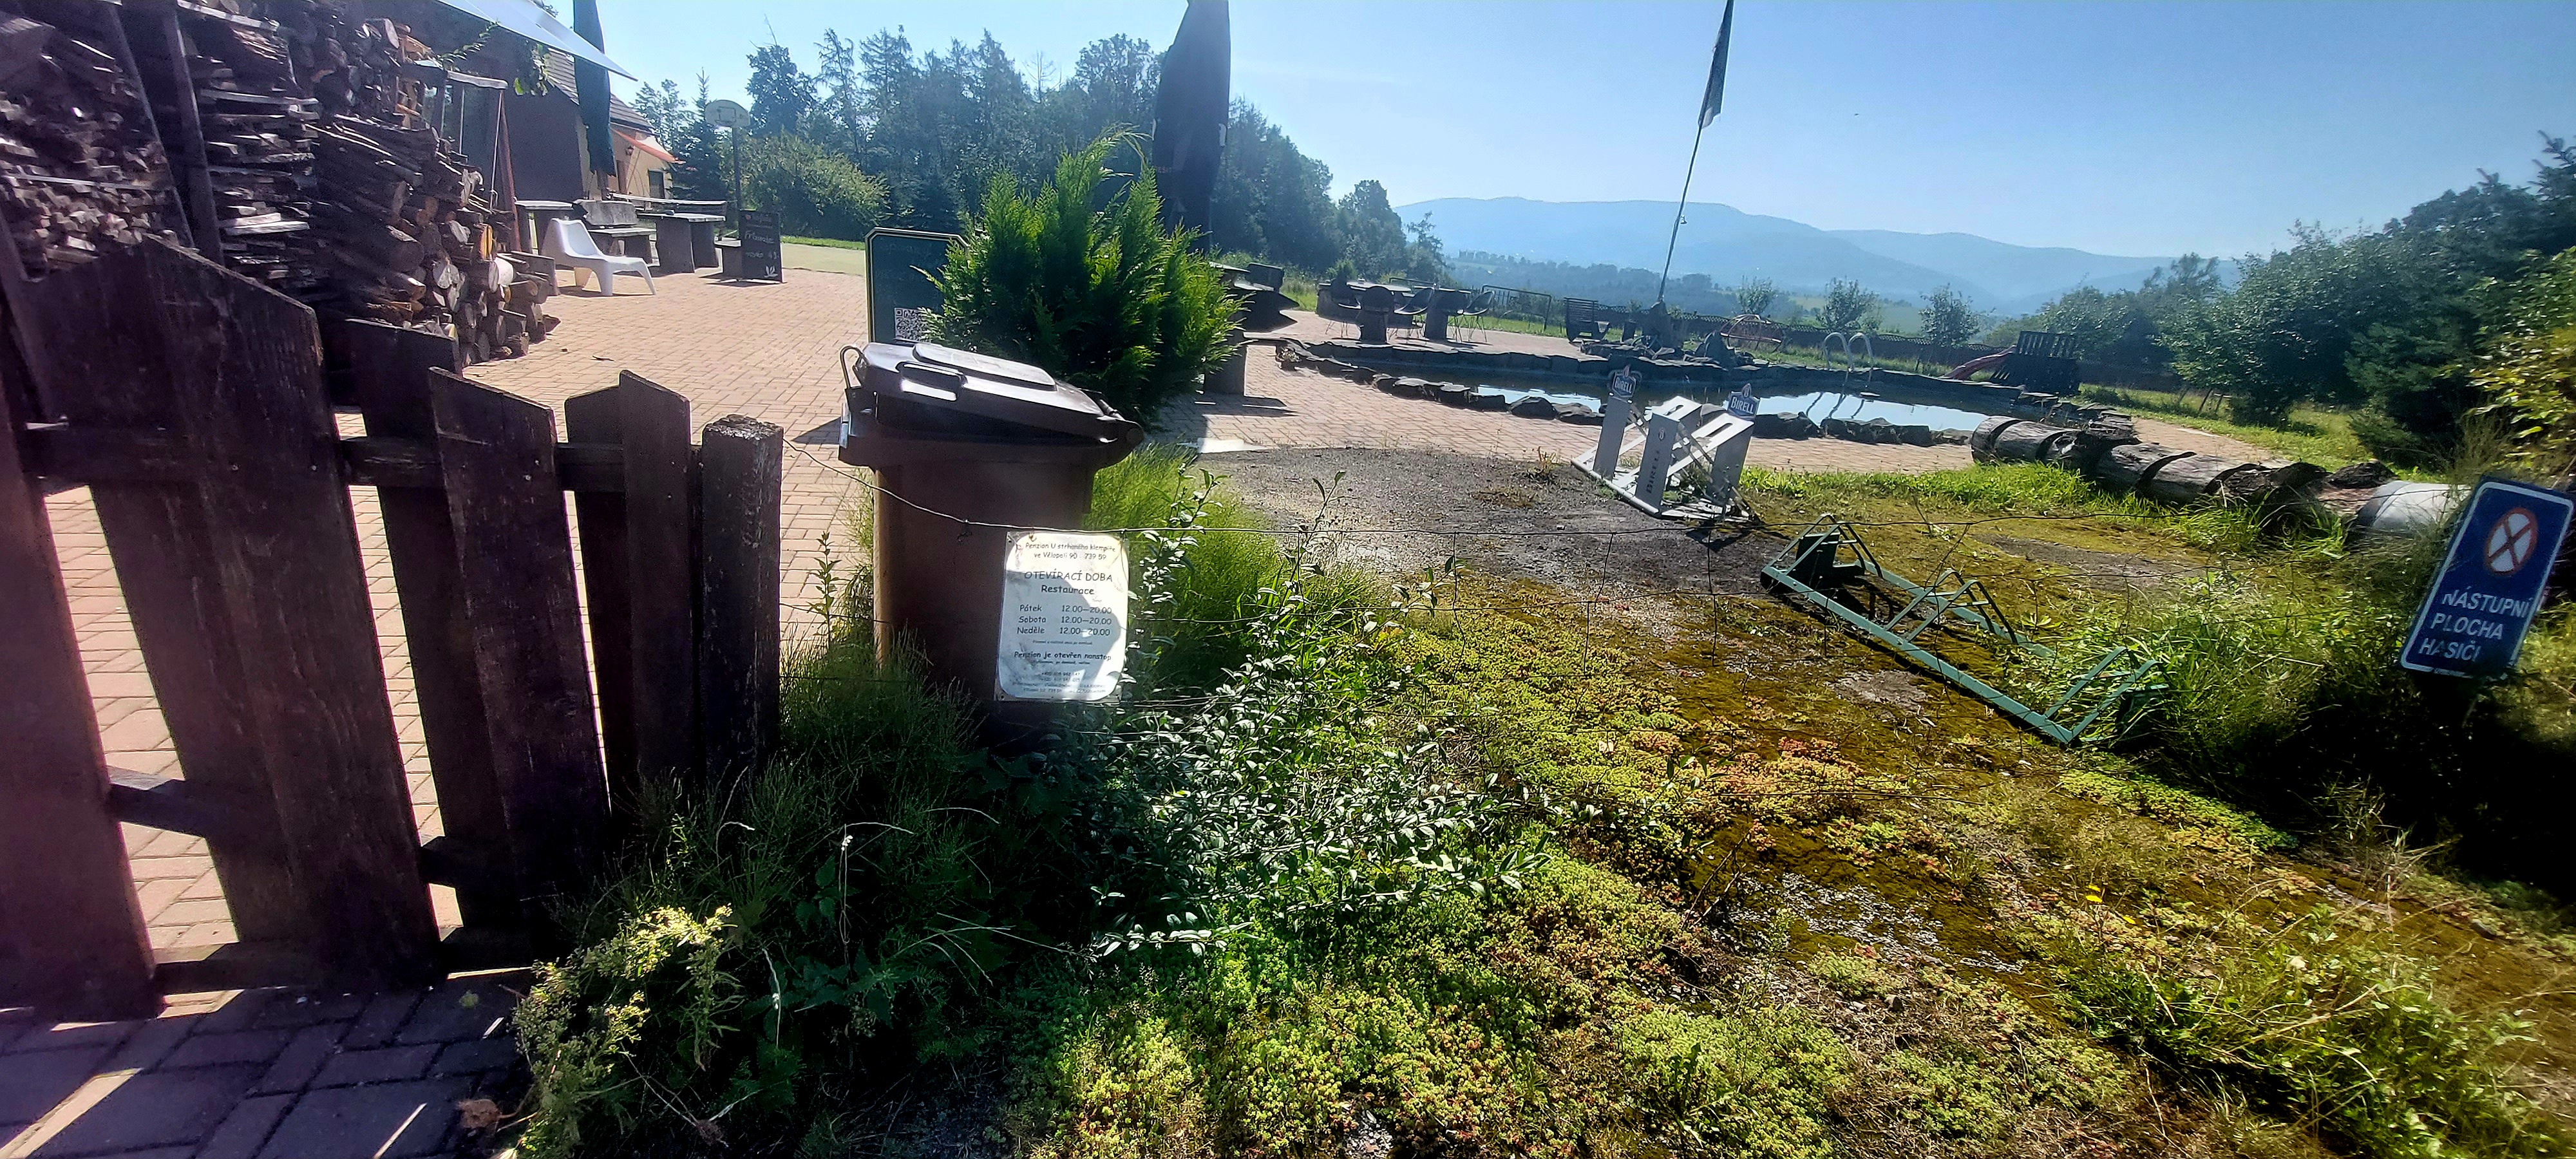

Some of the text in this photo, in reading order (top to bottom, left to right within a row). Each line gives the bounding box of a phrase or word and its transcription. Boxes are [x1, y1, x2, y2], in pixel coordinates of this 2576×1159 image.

[1730, 397, 1754, 414] BIRELL
[1024, 569, 1113, 582] OTEVÍRACÍ DOBA
[1041, 585, 1095, 595] Restaurace
[2441, 586, 2534, 618] NÁSTUPNÍ
[2430, 612, 2504, 640] PLOCHA
[1043, 651, 1051, 659] je
[1084, 654, 1112, 662] nonstop
